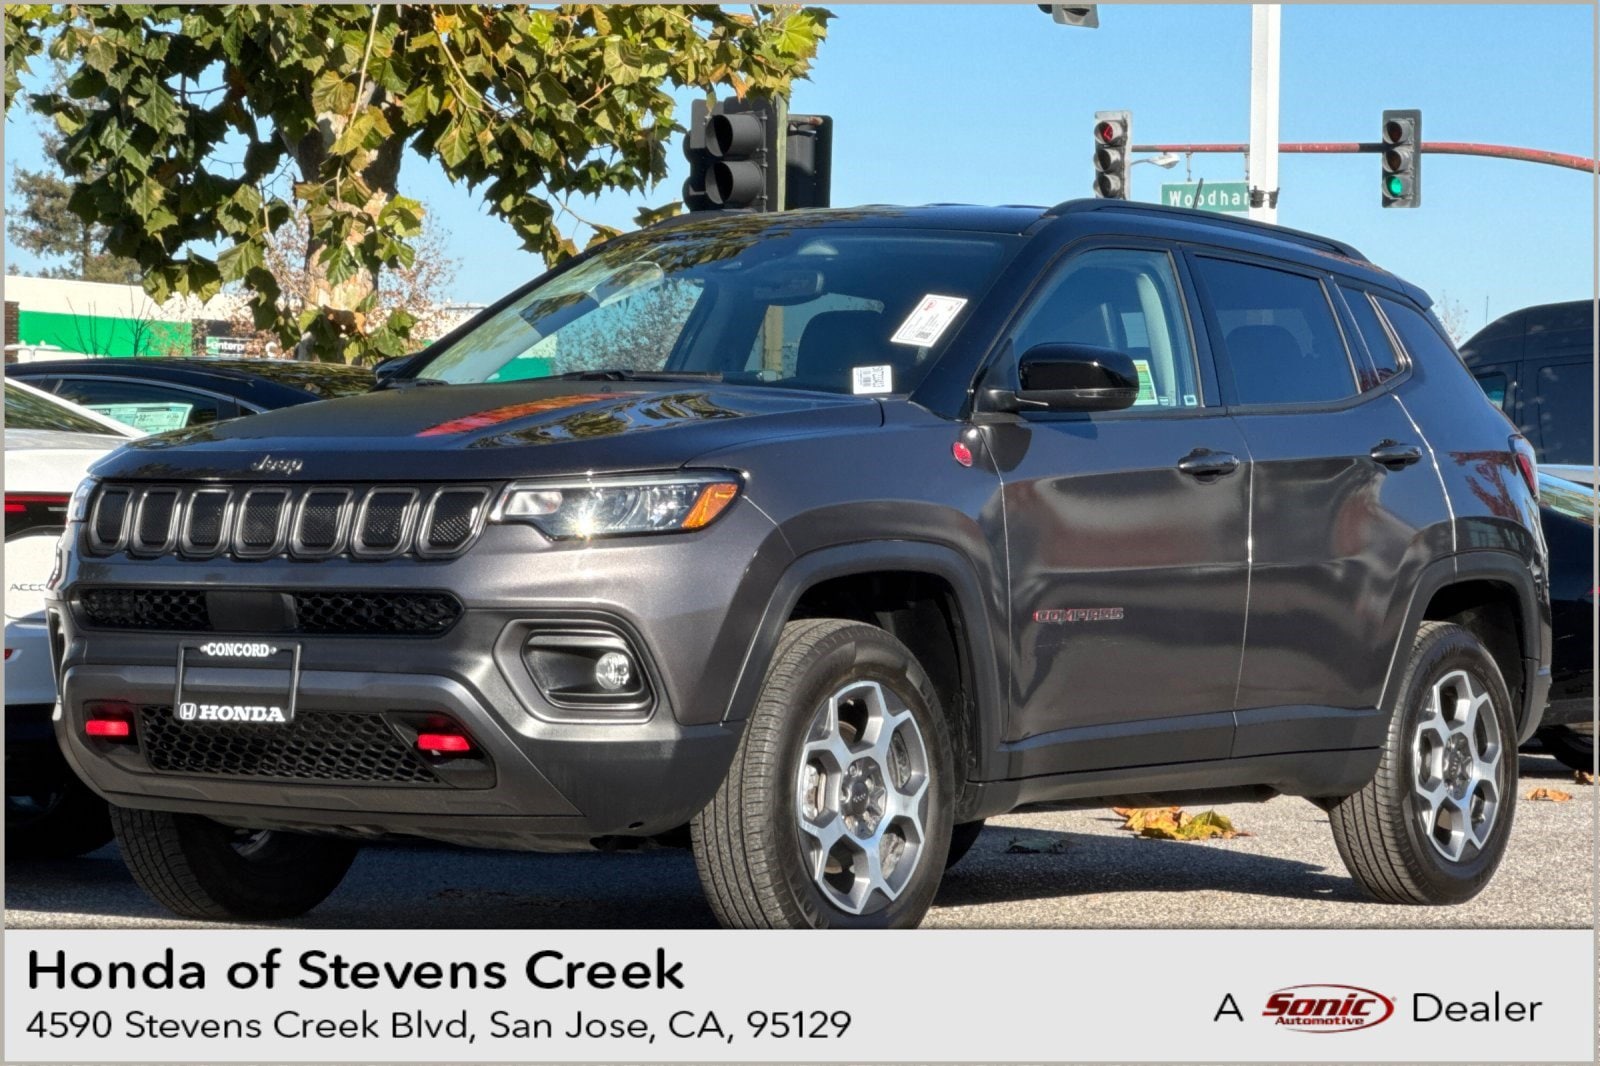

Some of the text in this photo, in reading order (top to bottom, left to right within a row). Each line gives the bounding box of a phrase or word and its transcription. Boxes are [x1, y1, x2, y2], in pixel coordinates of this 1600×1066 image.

[250, 455, 303, 476] Jeep
[1034, 607, 1124, 623] COMPASS
[207, 642, 269, 657] CONCORD
[199, 704, 286, 722] HONDA
